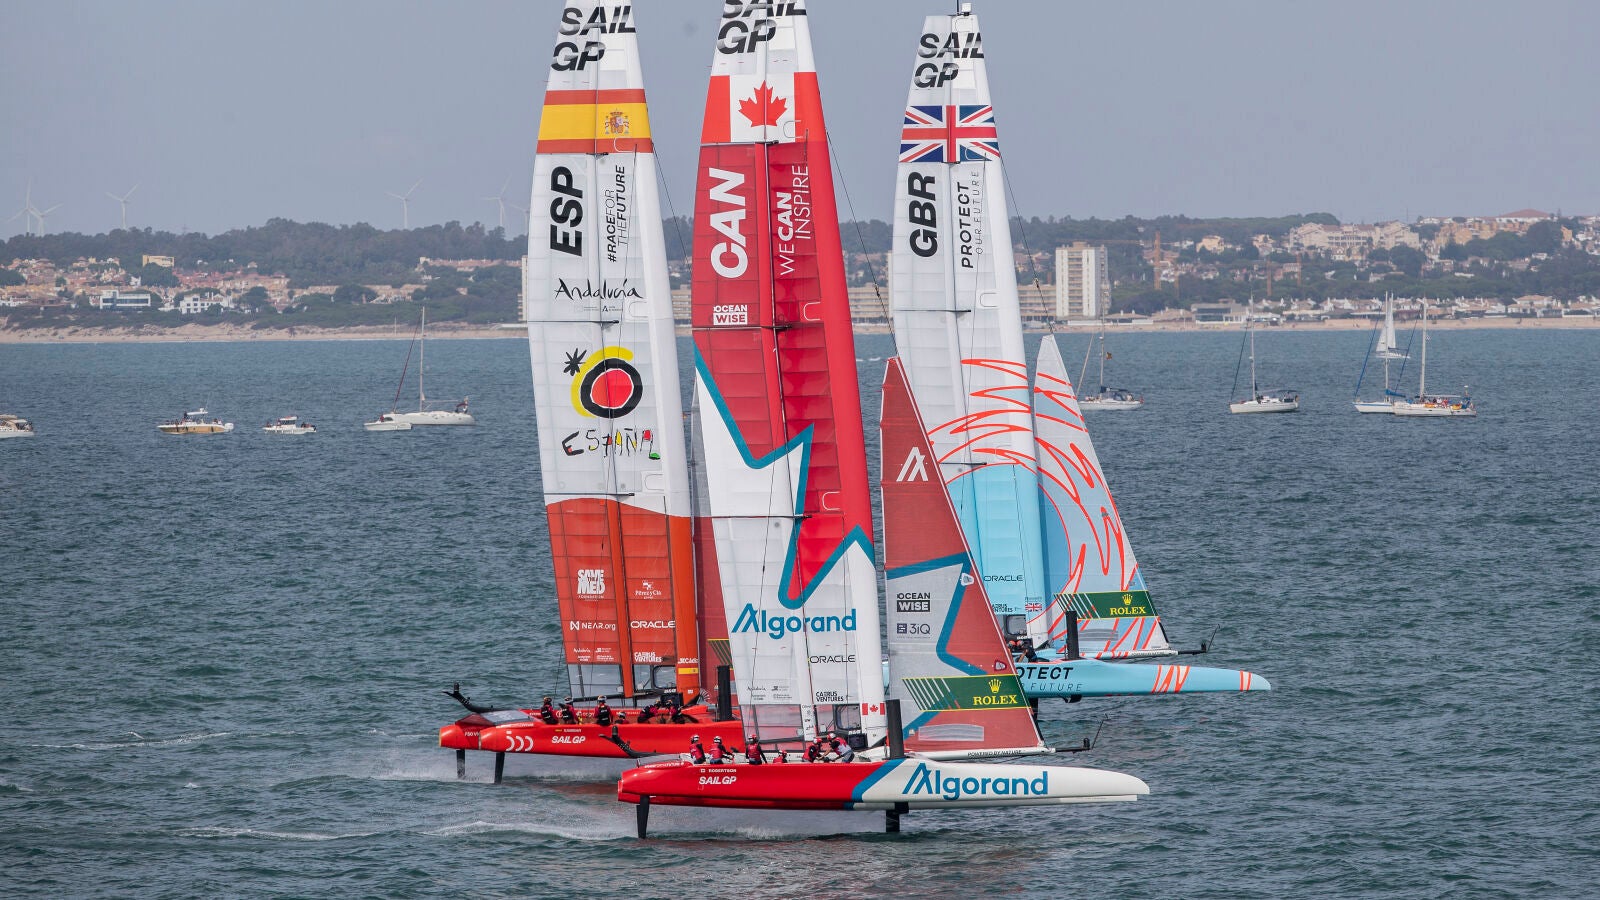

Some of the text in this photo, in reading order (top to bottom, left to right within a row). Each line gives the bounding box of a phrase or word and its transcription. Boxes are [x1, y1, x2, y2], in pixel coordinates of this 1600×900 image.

[559, 5, 636, 36] SAIL
[716, 19, 777, 54] GP
[918, 32, 984, 58] SAIL
[551, 41, 606, 71] GP
[914, 62, 960, 88] GP
[550, 166, 583, 257] ESP
[792, 165, 811, 240] INSPIRE
[708, 168, 748, 278] CAN
[908, 171, 938, 258] GBR
[957, 182, 974, 268] PROTECT
[554, 278, 644, 300] Andalucía
[714, 304, 748, 312] OCEAN
[716, 314, 746, 322] WISE
[578, 570, 604, 581] SAVE
[577, 580, 606, 594] MED
[896, 592, 930, 600] OCEAN
[898, 602, 928, 610] WISE
[1110, 606, 1146, 615] ROLEX
[582, 622, 616, 632] NEAR.org
[630, 620, 676, 628] ORACLE
[731, 603, 856, 640] Algorand
[910, 624, 930, 634] 3iQ
[810, 654, 856, 664] ORACLE
[1030, 682, 1083, 692] FUTURE
[973, 694, 1018, 706] ROLEX
[902, 762, 1048, 800] Algorand
